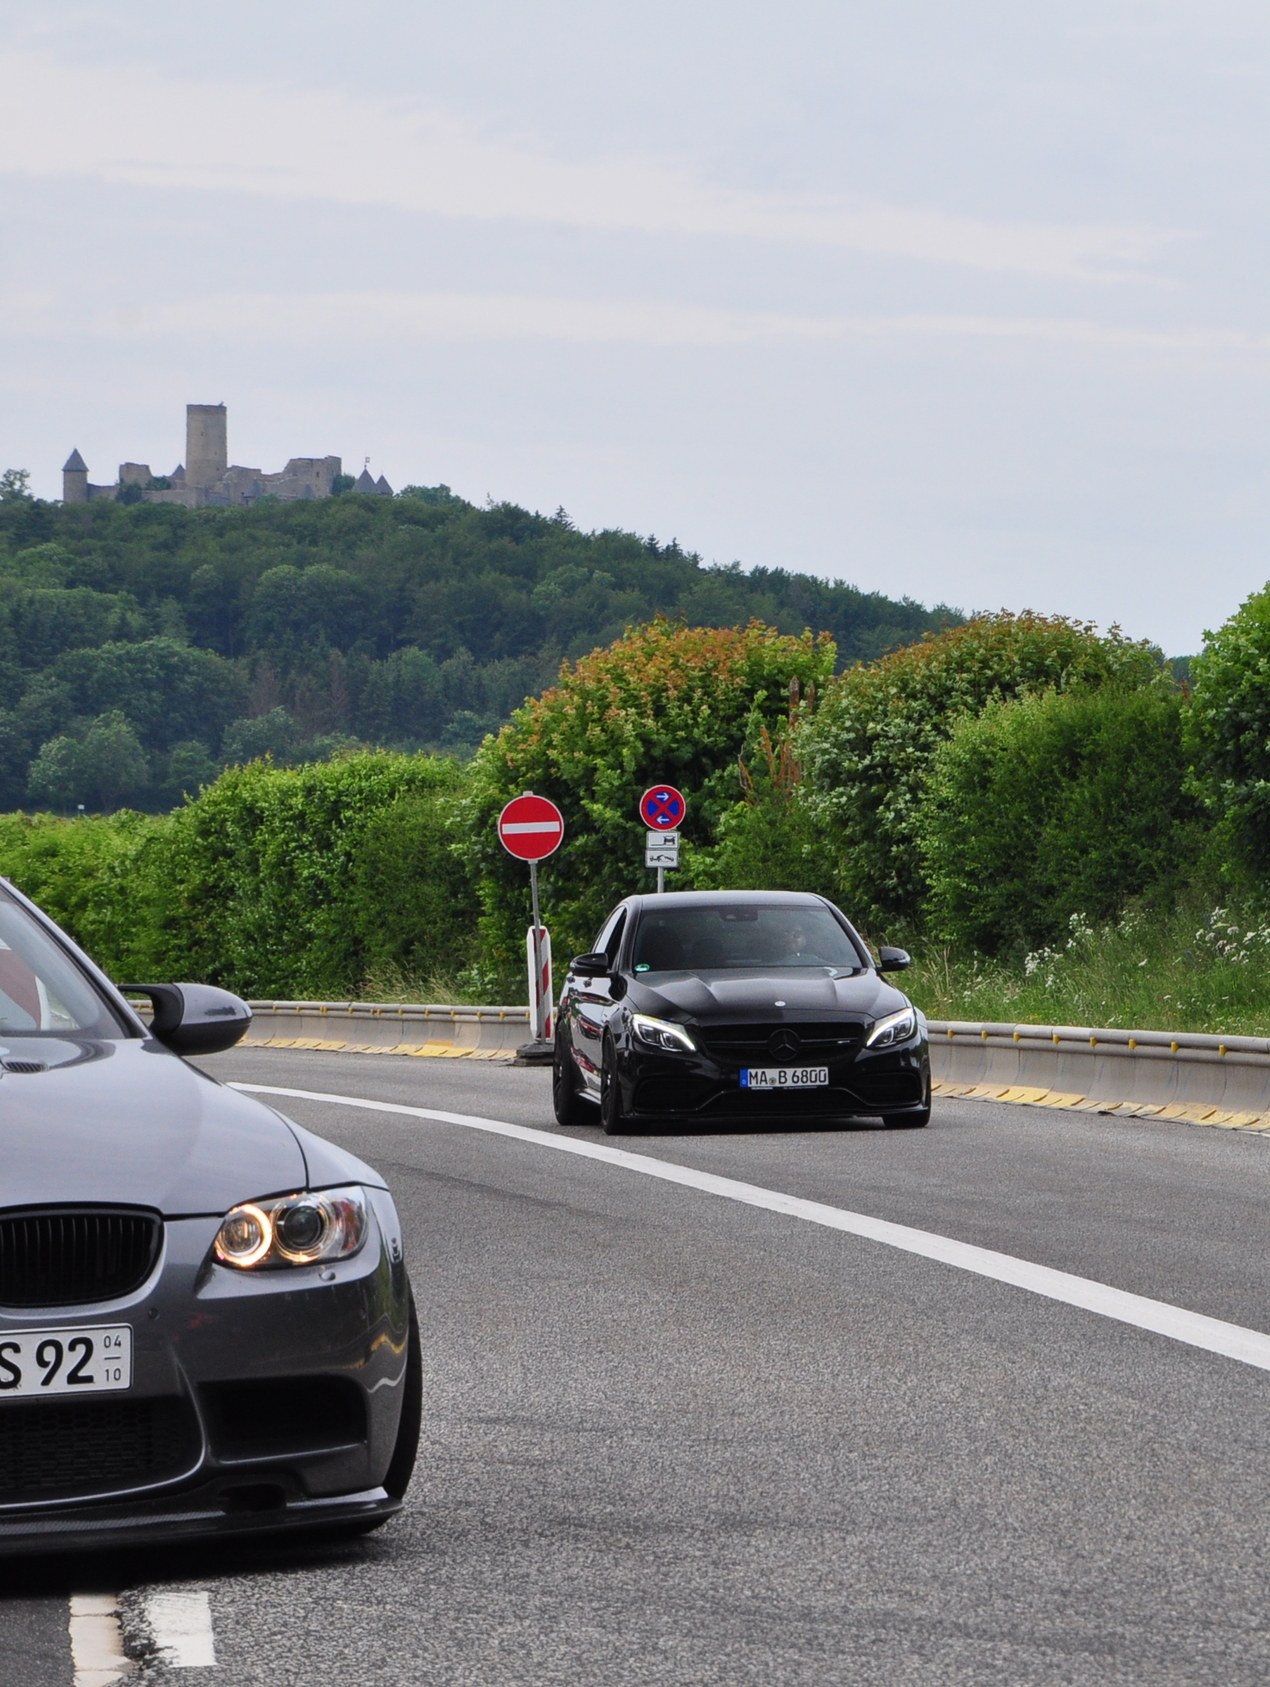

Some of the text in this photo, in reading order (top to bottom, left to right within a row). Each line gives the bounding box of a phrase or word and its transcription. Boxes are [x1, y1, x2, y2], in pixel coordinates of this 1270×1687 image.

[749, 1069, 827, 1085] MA B 6800
[103, 1335, 122, 1348] 04
[35, 1336, 95, 1387] 92
[105, 1367, 122, 1382] 10
